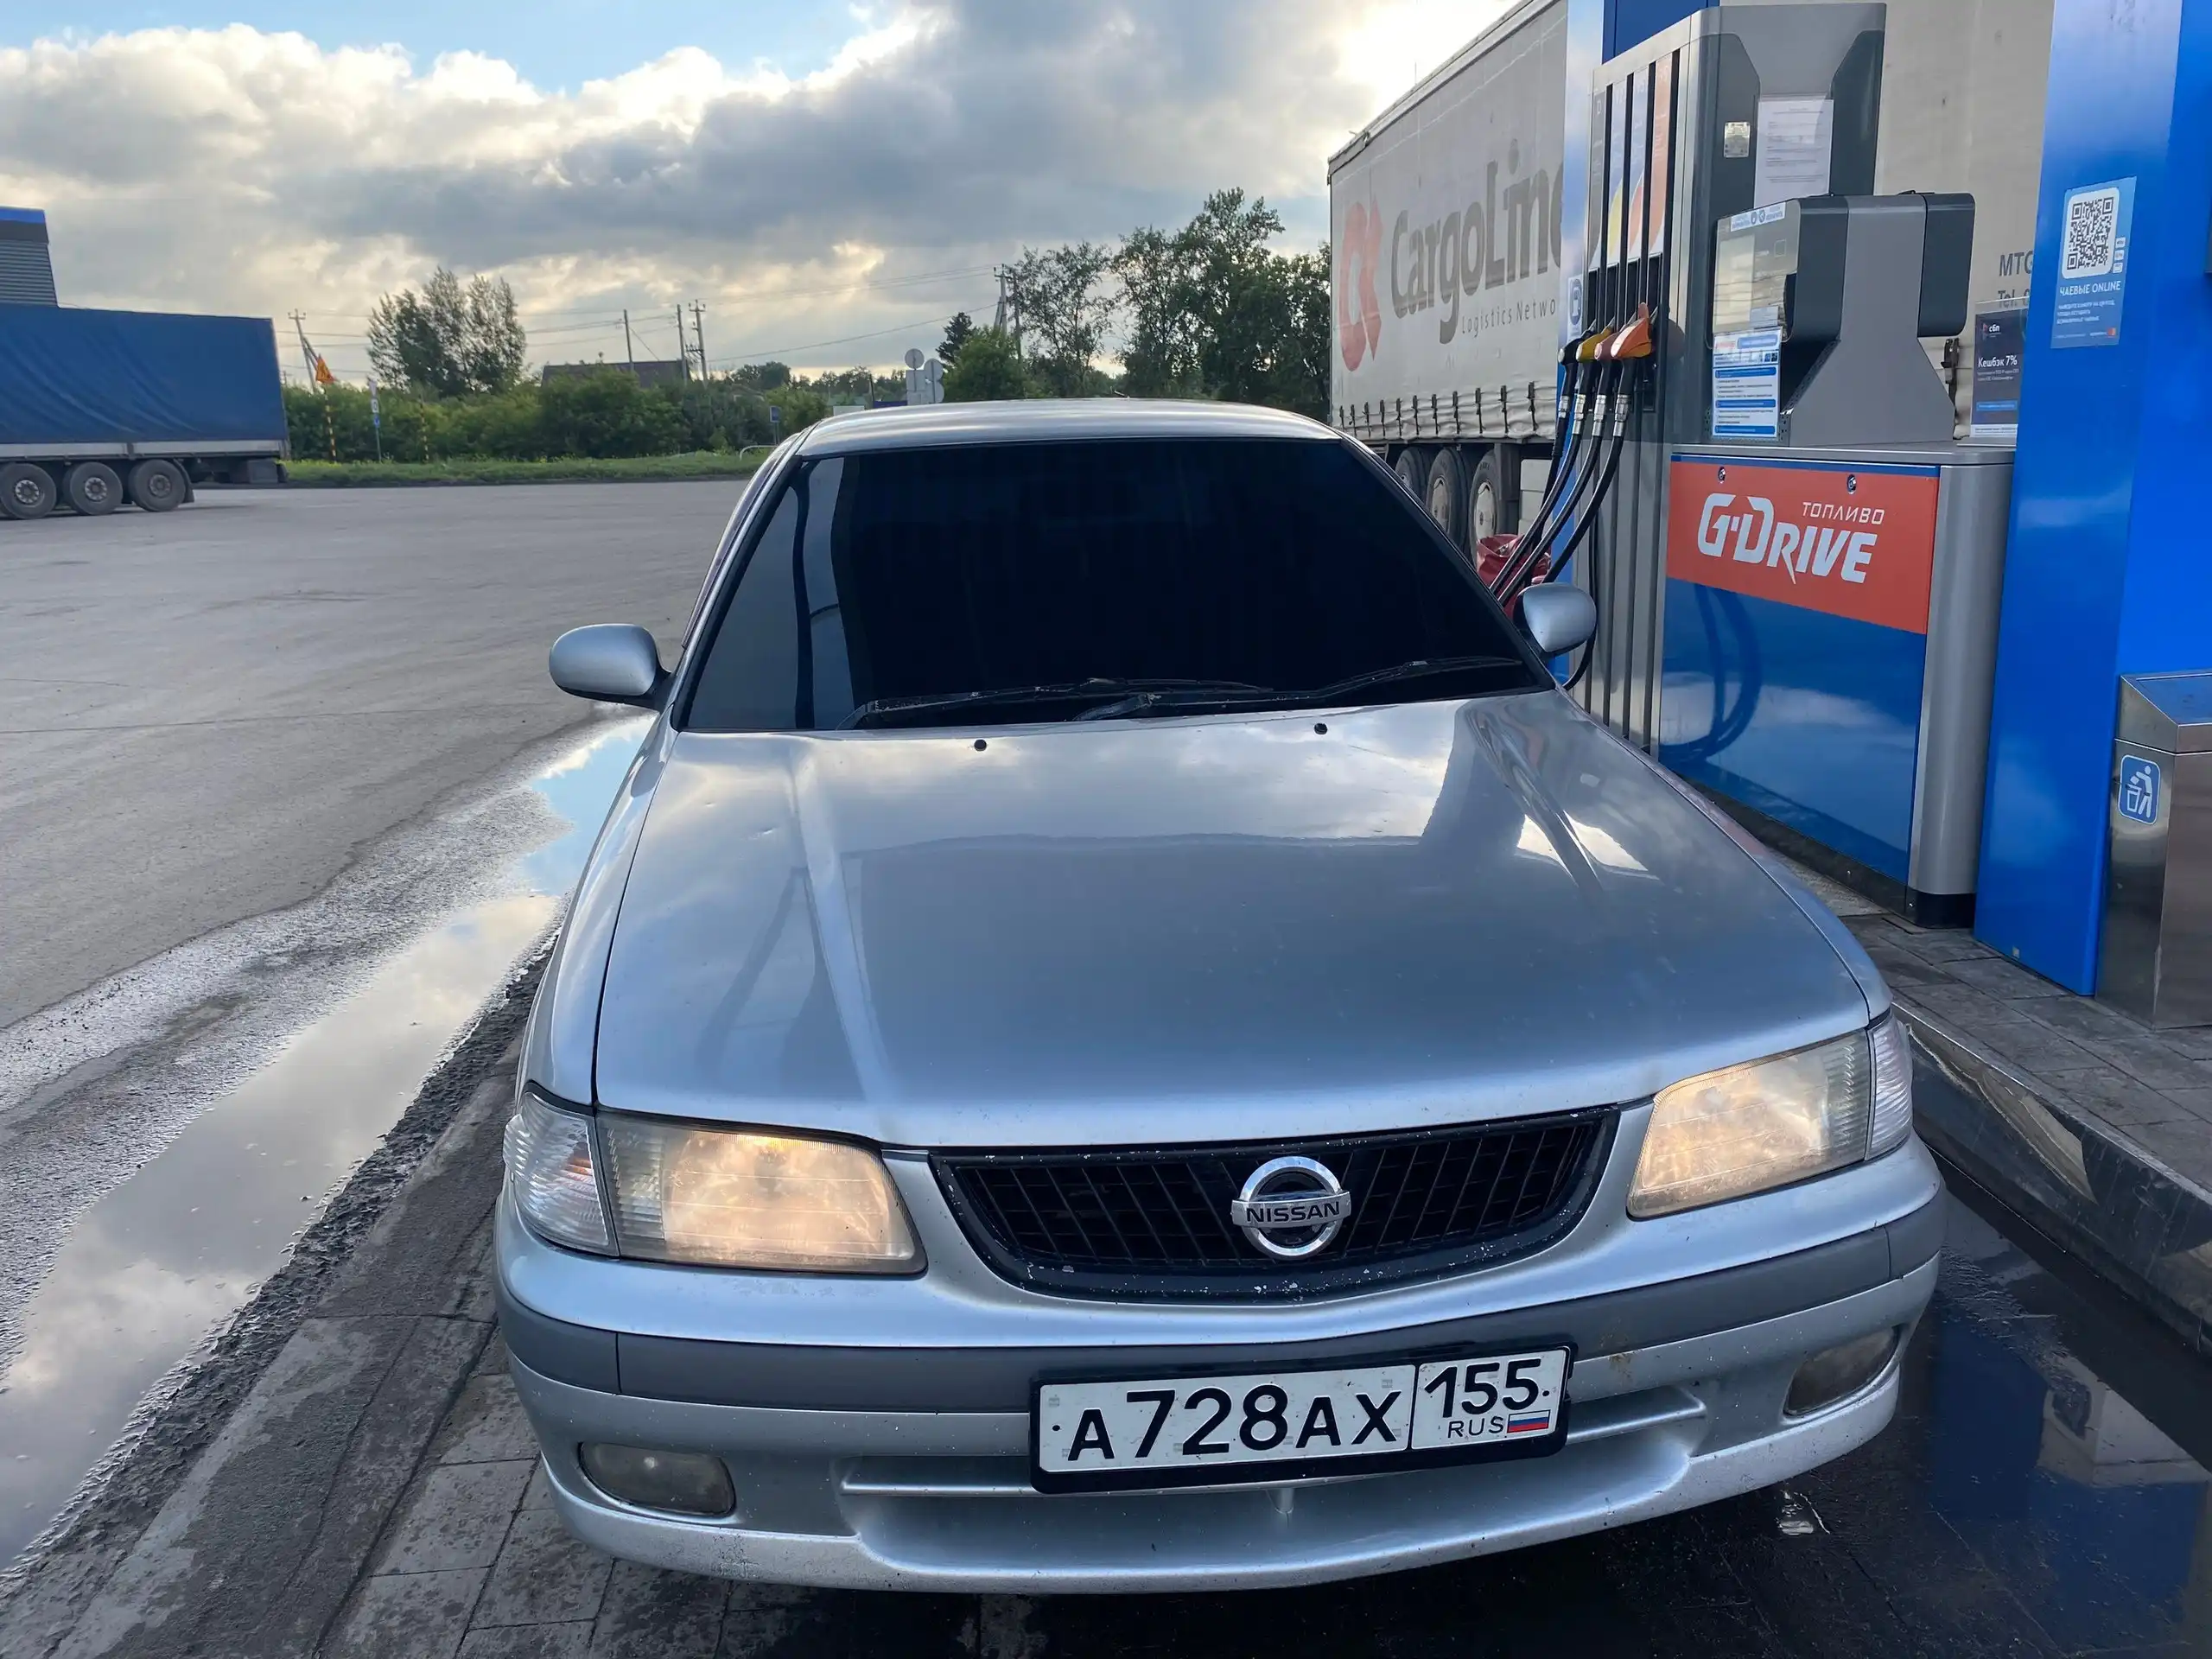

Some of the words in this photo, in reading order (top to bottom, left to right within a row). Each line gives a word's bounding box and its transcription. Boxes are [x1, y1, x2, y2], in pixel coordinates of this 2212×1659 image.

[2060, 283, 2090, 296] ЧАЕВЫЕ
[2092, 280, 2121, 293] ONLINE
[1462, 306, 1512, 338] Logistics
[1978, 356, 2005, 368] Кешбэк
[2005, 354, 2018, 365] 7%
[1802, 501, 1885, 525] ТОПЛИВО
[1246, 1201, 1339, 1223] NISSAN
[1424, 1359, 1541, 1419] 155
[1446, 1415, 1504, 1440] RUS
